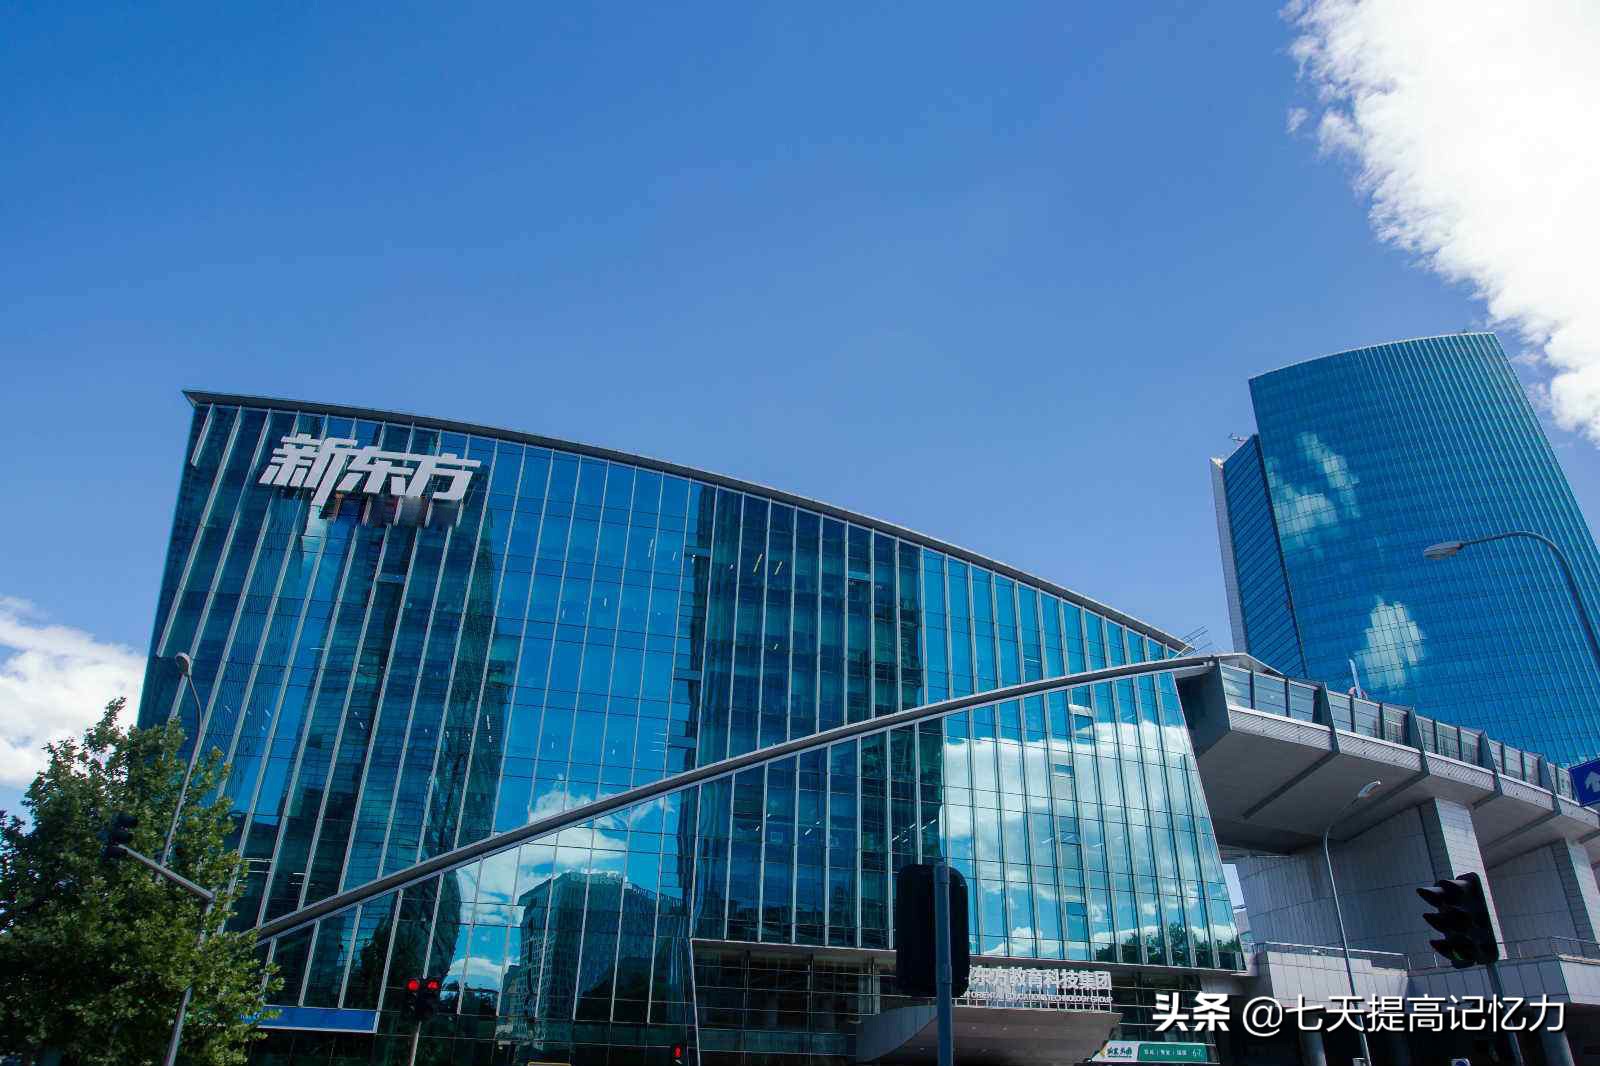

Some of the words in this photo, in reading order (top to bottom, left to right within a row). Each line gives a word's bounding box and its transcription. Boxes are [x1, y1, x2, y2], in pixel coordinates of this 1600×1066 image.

[258, 433, 481, 507] 新东方
[1091, 996, 1113, 1004] GROUP
